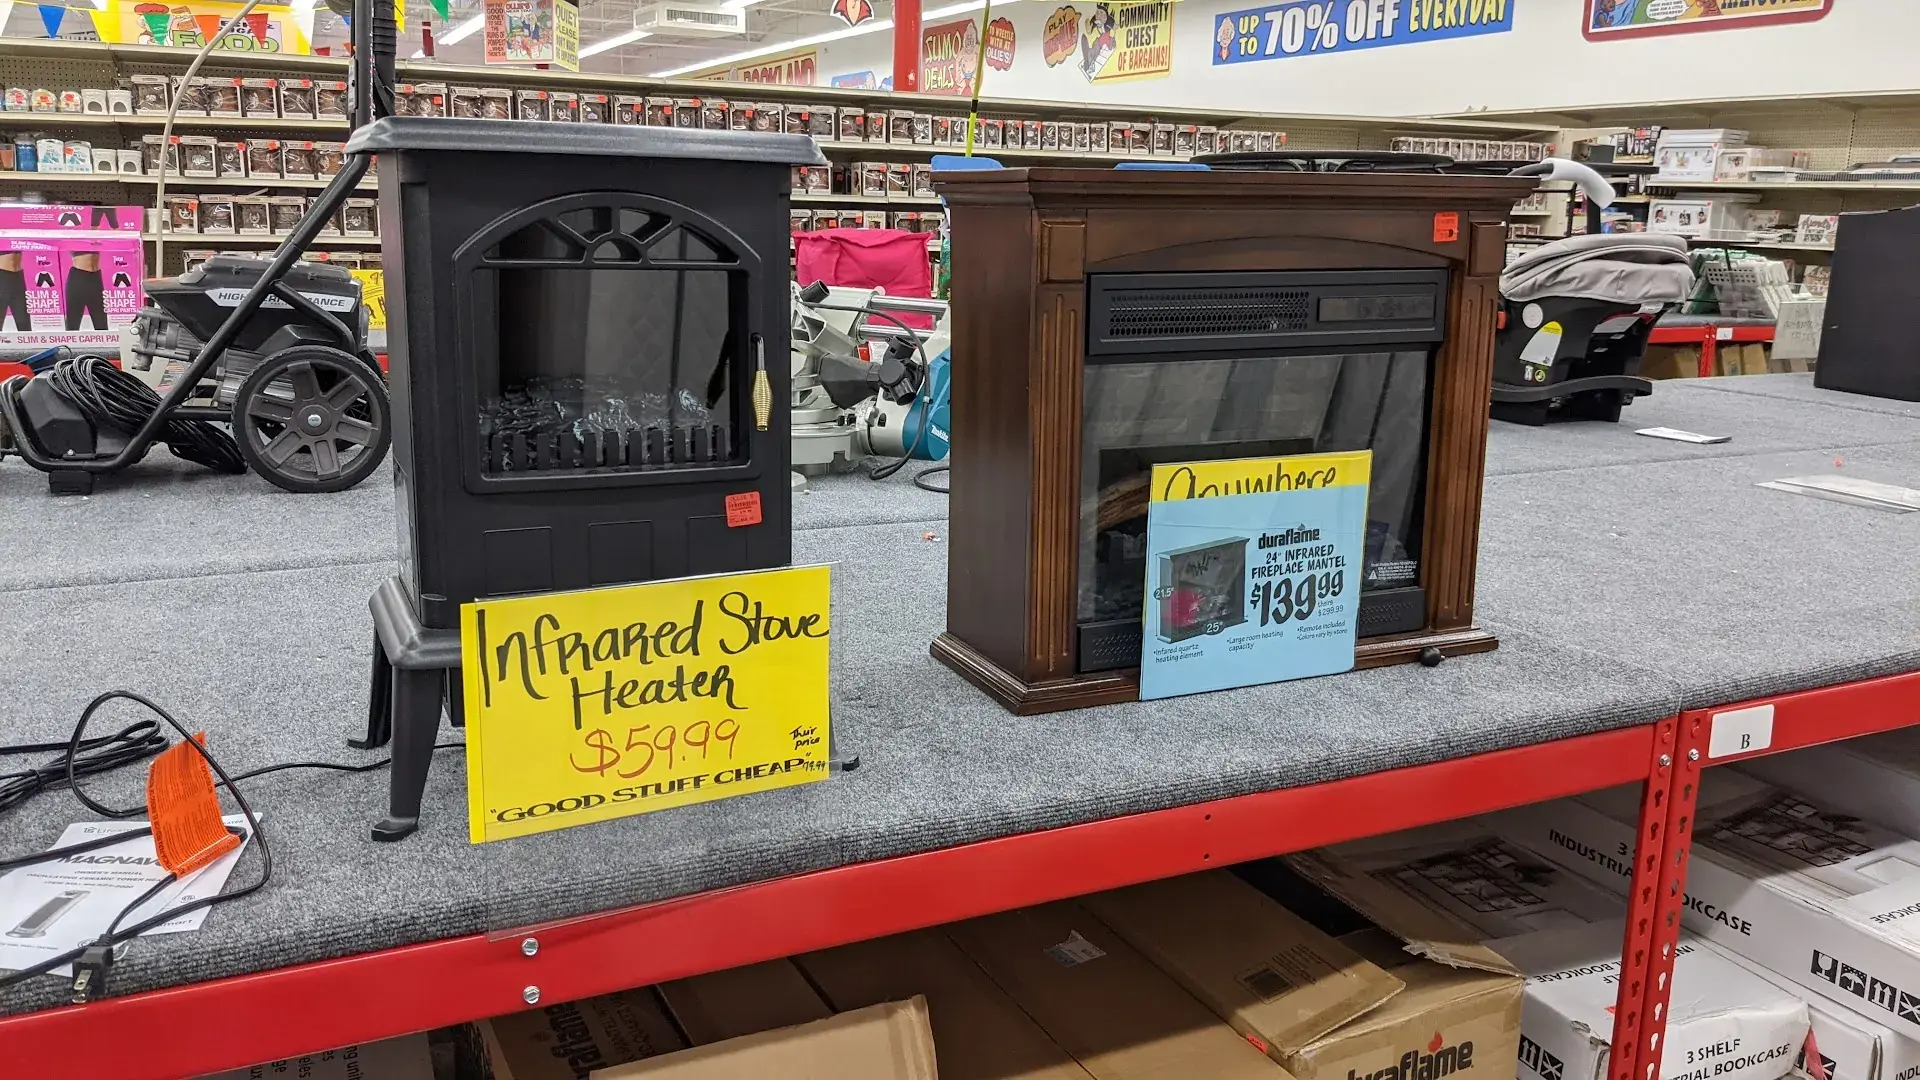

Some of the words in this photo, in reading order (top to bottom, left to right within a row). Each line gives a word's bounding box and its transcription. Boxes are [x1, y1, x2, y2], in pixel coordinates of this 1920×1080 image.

[555, 4, 577, 28] QUIET
[1048, 13, 1067, 34] PLAY
[1120, 2, 1169, 28] COMMUNITY
[1238, 15, 1260, 35] UP
[1263, 1, 1339, 56] 70%
[1345, 0, 1400, 42] OFF
[1408, 0, 1507, 33] EVERYDAY
[989, 36, 1002, 47] WITH
[1003, 41, 1011, 50] AT
[1126, 24, 1158, 48] CHEST
[925, 30, 961, 64] SUMO
[986, 46, 1012, 64] OLLIE'S!
[1238, 37, 1258, 56] TO
[1118, 51, 1127, 71] OF
[1129, 46, 1168, 70] BARGAINS!
[925, 64, 954, 91] DEALS
[25, 290, 49, 299] SLIM
[51, 290, 60, 299] &
[102, 290, 127, 299] SLIM
[128, 290, 136, 299] &
[103, 299, 136, 308] SHAPE
[26, 299, 60, 309] SHAPE
[18, 336, 39, 344] SLIM
[40, 335, 48, 344] &
[78, 335, 104, 343] CAPRI
[1258, 528, 1320, 550] duraflame
[1285, 544, 1334, 562] INFRARED
[1252, 560, 1304, 579] FIREPLACE
[1307, 555, 1346, 571] MANTEL
[1318, 604, 1344, 617] $299.99
[718, 591, 830, 655] Stove
[1299, 623, 1321, 634] Remote
[1322, 620, 1346, 631] included
[1228, 636, 1245, 645] Large
[1246, 634, 1261, 642] room
[1262, 630, 1284, 641] heating
[1316, 631, 1327, 640] vary
[1178, 643, 1199, 654] quartz
[1228, 642, 1255, 652] capacity
[1155, 654, 1179, 664] heating
[1180, 651, 1204, 661] element
[570, 718, 741, 779] $59.99
[794, 737, 820, 750] price
[1741, 733, 1751, 749] B
[611, 774, 711, 803] STUFF
[1617, 843, 1628, 856] 3
[1534, 963, 1615, 983] BOOKCASE
[1687, 1051, 1694, 1064] 3
[1698, 1038, 1741, 1062] SHELF
[1714, 1044, 1791, 1077] BOOKCASE
